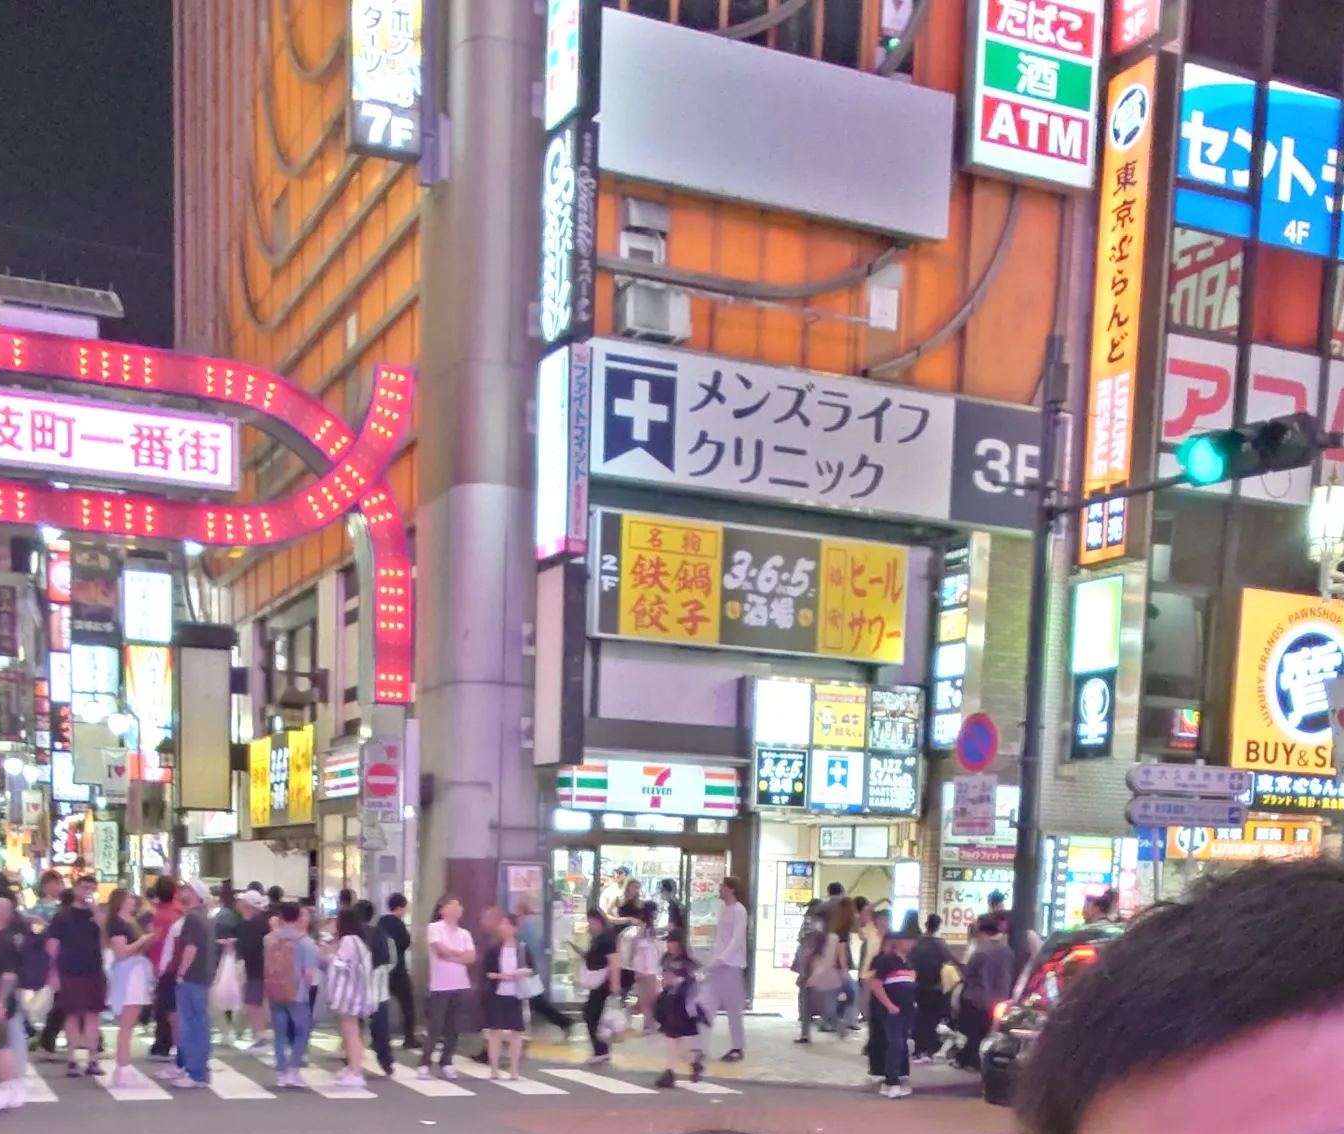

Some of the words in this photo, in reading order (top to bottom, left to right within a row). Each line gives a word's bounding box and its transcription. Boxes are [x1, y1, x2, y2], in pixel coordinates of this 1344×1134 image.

[997, 0, 1084, 52] たばこ
[1016, 52, 1060, 100] 酒
[360, 101, 414, 149] 7F
[988, 107, 1084, 160] ATM
[1282, 218, 1311, 244] 4F
[689, 369, 932, 444] メンズライフ
[1092, 377, 1113, 477] RESALE
[1109, 371, 1132, 471] LUXURY
[688, 430, 884, 499] クリニック
[972, 437, 1042, 496] 3F
[647, 527, 702, 554] 名物
[630, 553, 713, 599] 鉄鍋
[849, 555, 903, 605] ビール
[629, 594, 711, 636] 餃子
[744, 594, 795, 630] 酒場
[847, 609, 902, 654] サワー
[1288, 607, 1344, 626] PAWNSHOP
[1258, 622, 1285, 672] BRANDS
[1257, 676, 1274, 728] LUXURY
